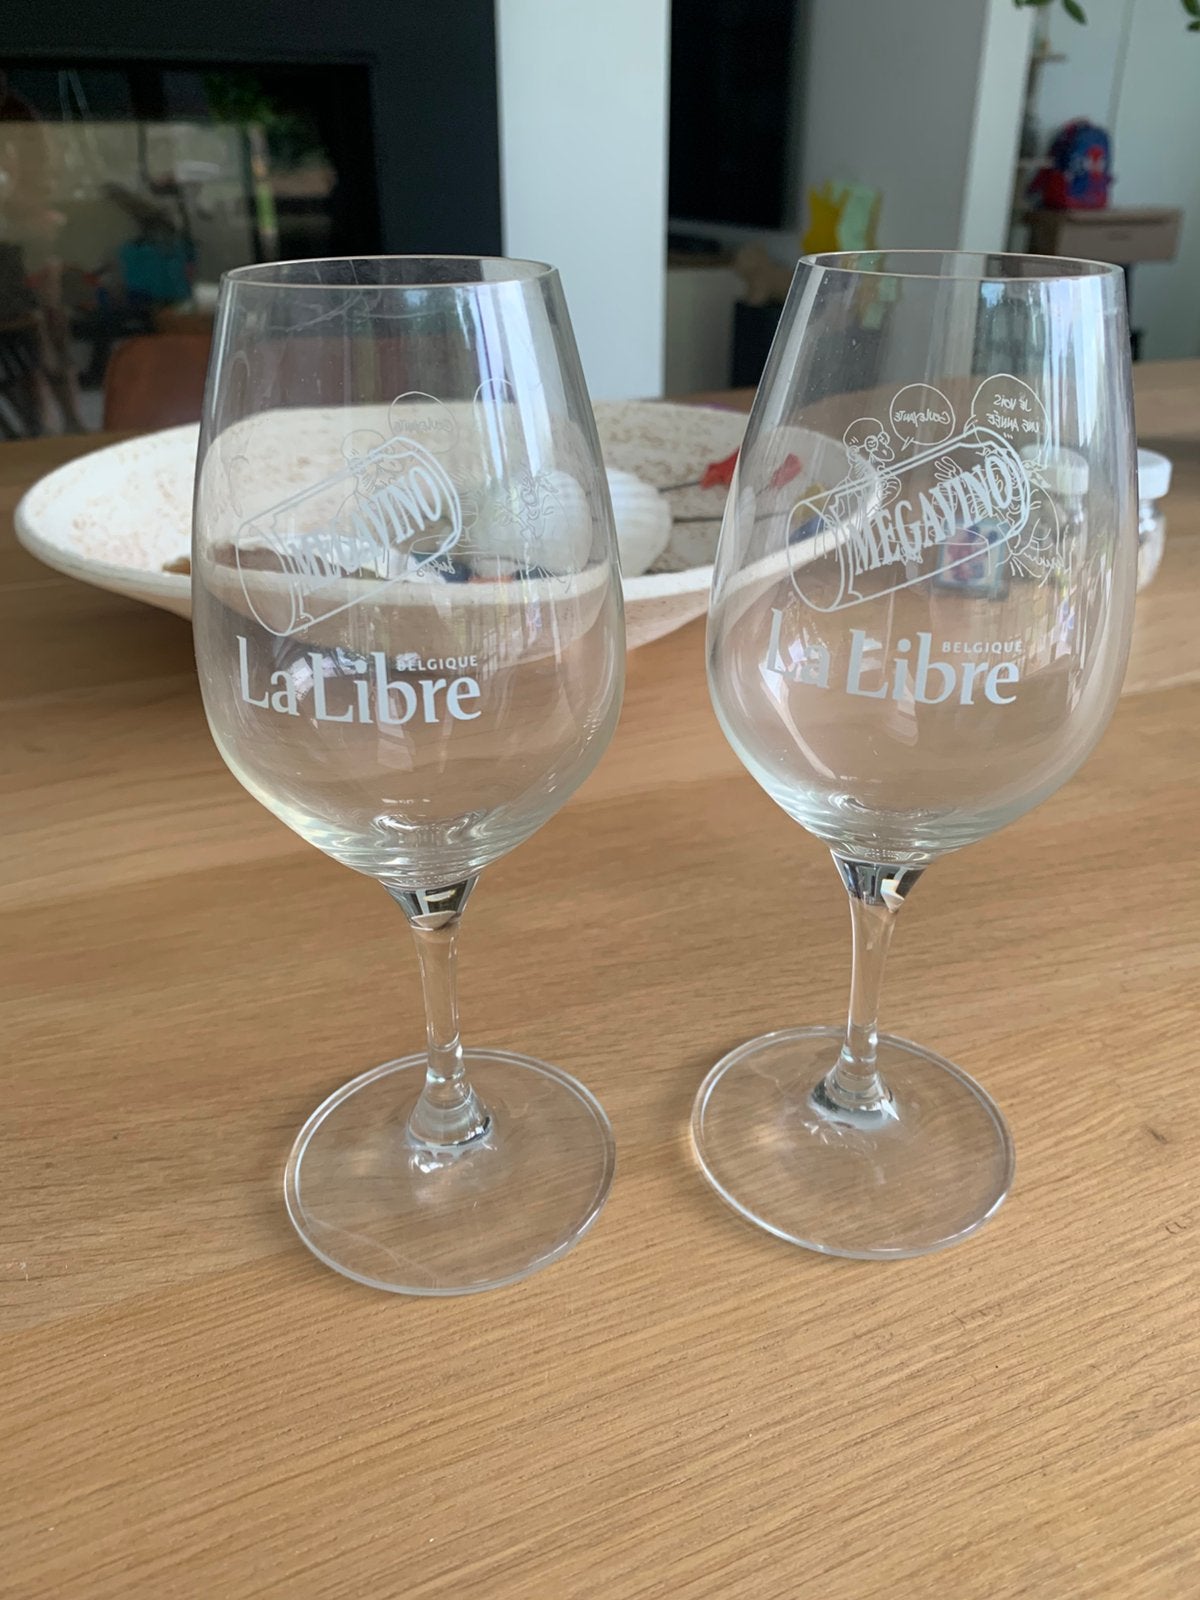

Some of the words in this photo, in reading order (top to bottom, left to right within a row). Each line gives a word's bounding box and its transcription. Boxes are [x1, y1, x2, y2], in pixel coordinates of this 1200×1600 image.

[848, 454, 1013, 577] MEGAVINO
[235, 634, 300, 717] La
[311, 650, 483, 726] Libre
[845, 629, 1020, 706] Libre
[942, 640, 1023, 654] BELGIQUE
